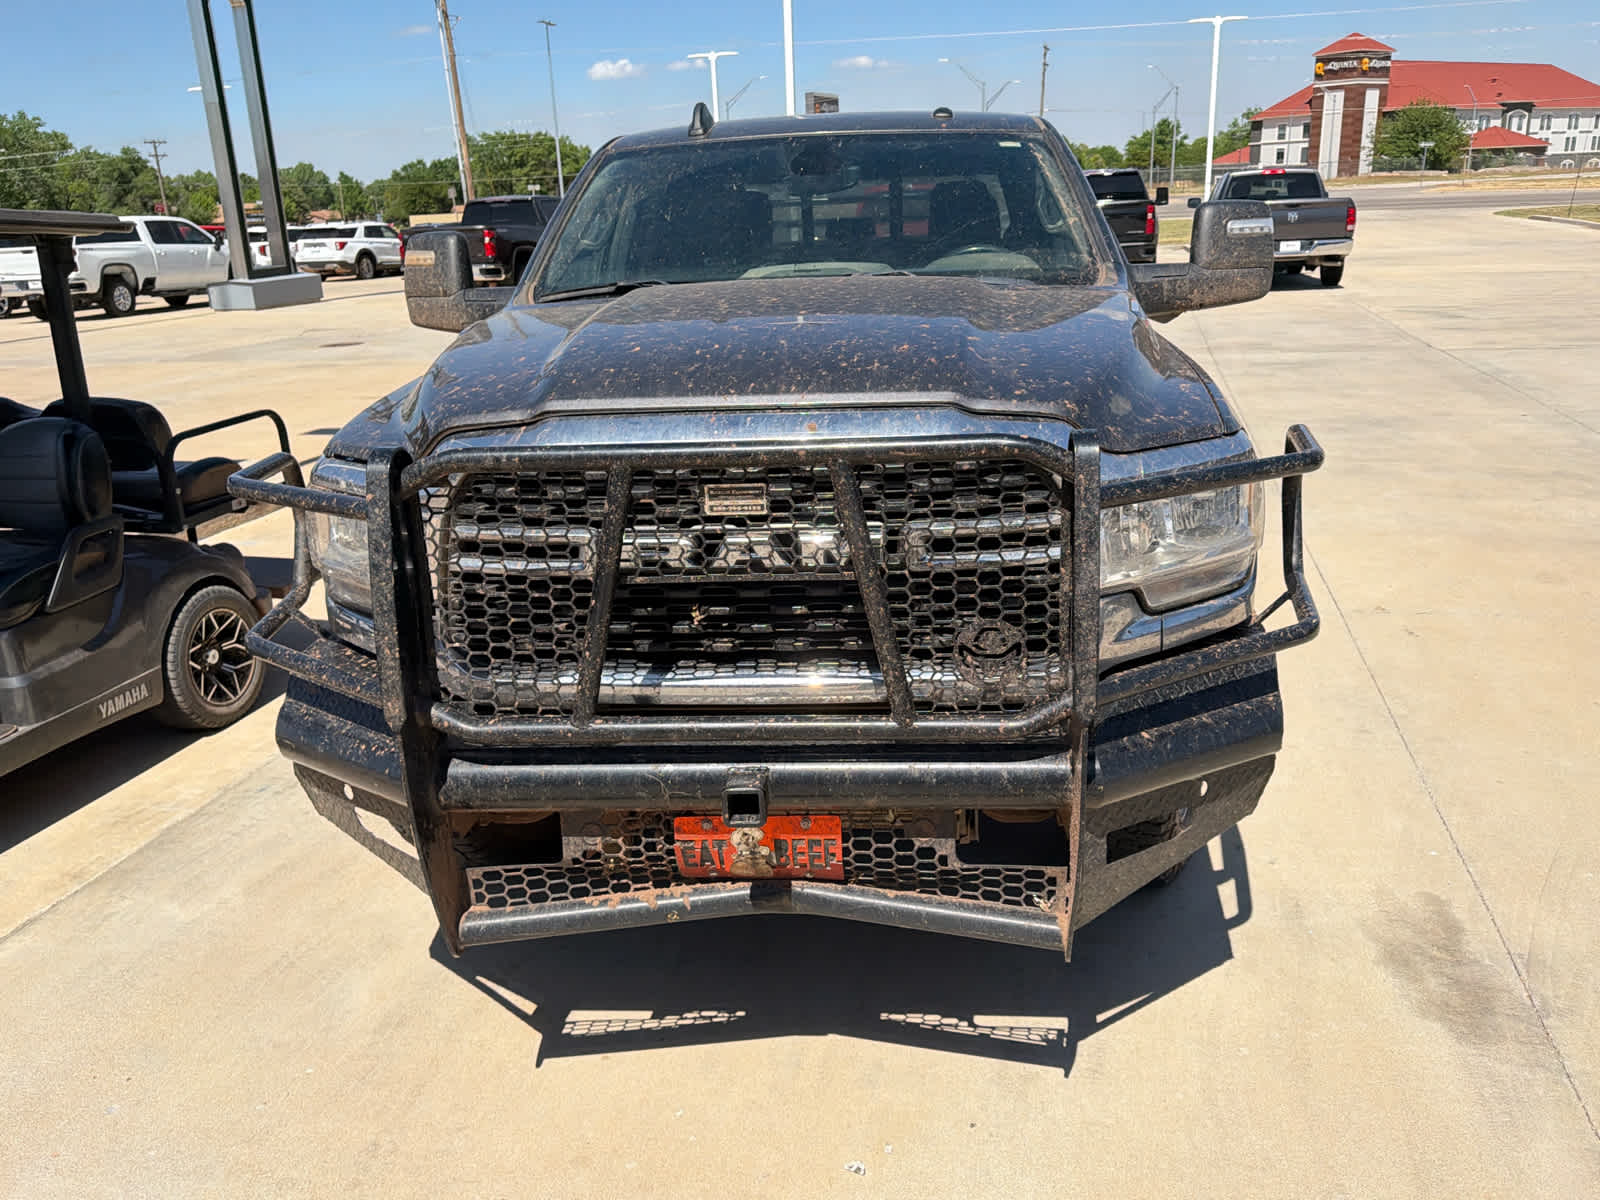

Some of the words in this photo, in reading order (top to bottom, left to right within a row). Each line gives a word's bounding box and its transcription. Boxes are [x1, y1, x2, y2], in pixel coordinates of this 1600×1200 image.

[99, 683, 149, 719] YAMAHA
[675, 839, 729, 868] EAT
[773, 838, 839, 870] BEEF
